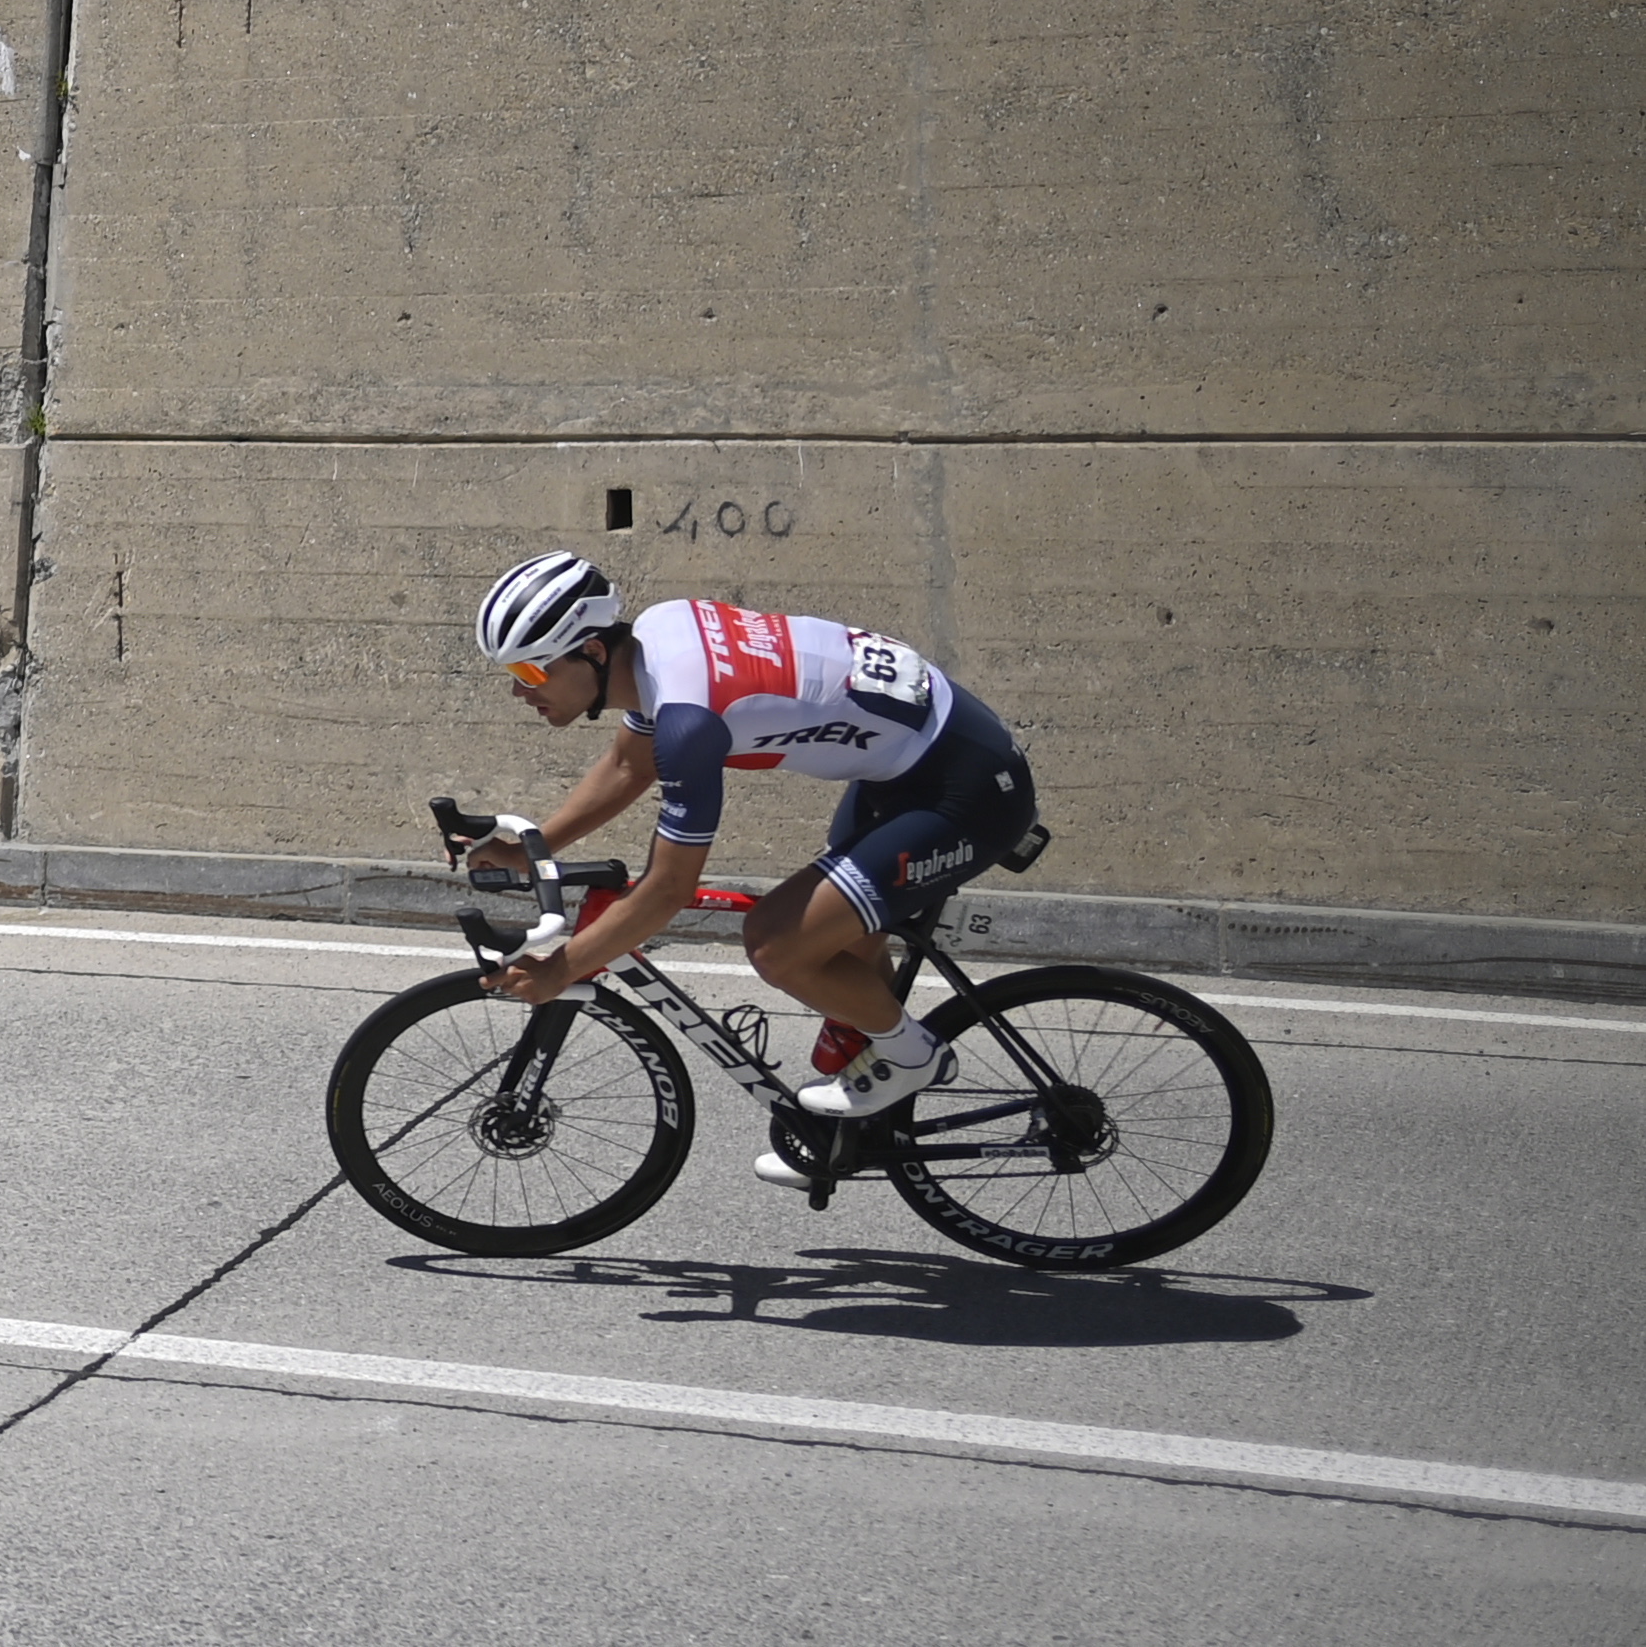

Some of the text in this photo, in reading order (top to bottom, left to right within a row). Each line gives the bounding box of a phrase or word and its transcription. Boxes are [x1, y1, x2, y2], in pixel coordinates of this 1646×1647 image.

[662, 500, 796, 542] 400
[862, 646, 897, 683] 63
[752, 720, 881, 751] TREK
[892, 840, 974, 887] Segafredo
[968, 914, 992, 935] 63
[607, 951, 798, 1112] TREK
[1138, 991, 1215, 1034] AEOLUS
[513, 1047, 548, 1113] TREK
[371, 1182, 434, 1229] AEOLUS
